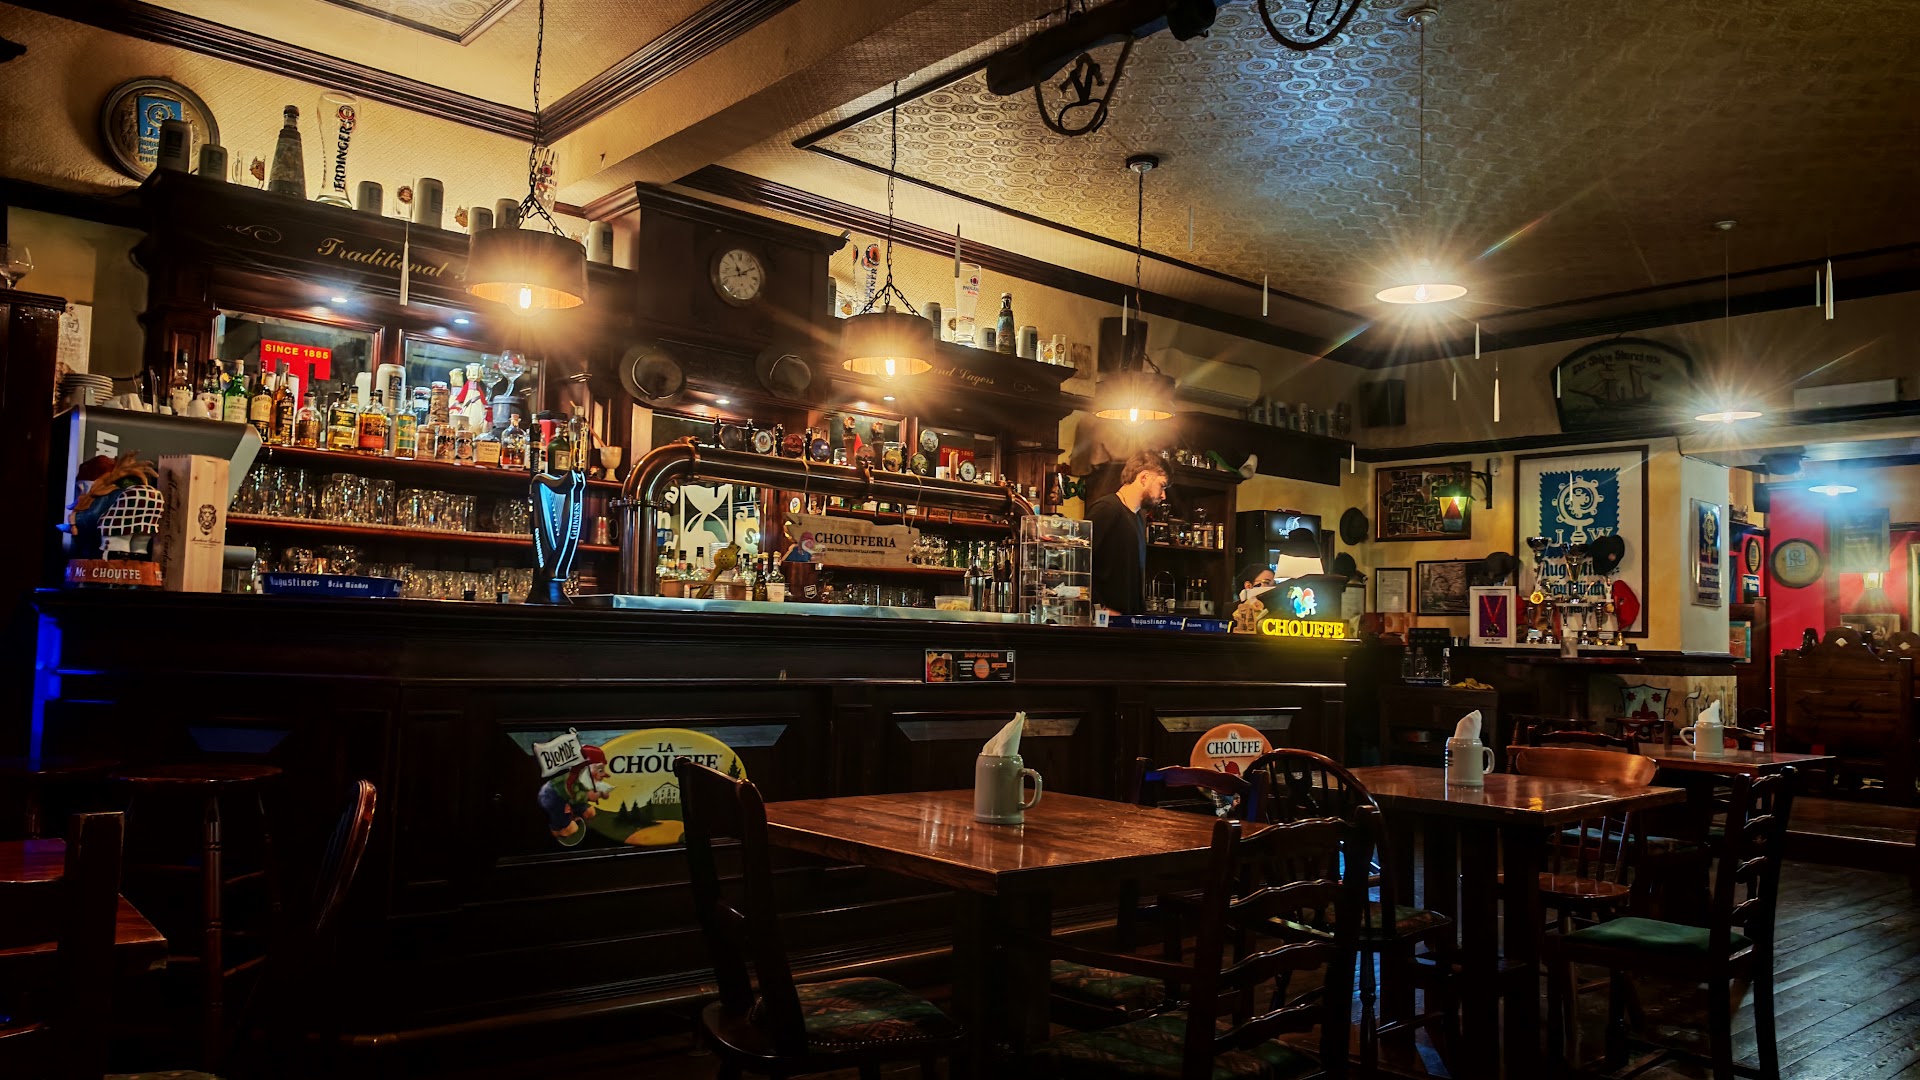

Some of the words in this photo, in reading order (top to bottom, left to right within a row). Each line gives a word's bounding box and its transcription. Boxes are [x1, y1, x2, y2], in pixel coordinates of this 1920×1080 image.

[334, 122, 354, 191] ERDINGER
[264, 343, 299, 355] SINCE
[303, 349, 329, 360] 1885
[959, 368, 994, 386] Lagers
[568, 502, 581, 540] GUINNESS
[814, 532, 896, 548] CHOUFFERIA
[92, 567, 141, 580] CHOUFFE
[1261, 617, 1345, 639] CHOUFFE
[540, 739, 577, 771] BLONDE
[658, 743, 674, 753] LA
[1206, 740, 1261, 755] CHOUFFE
